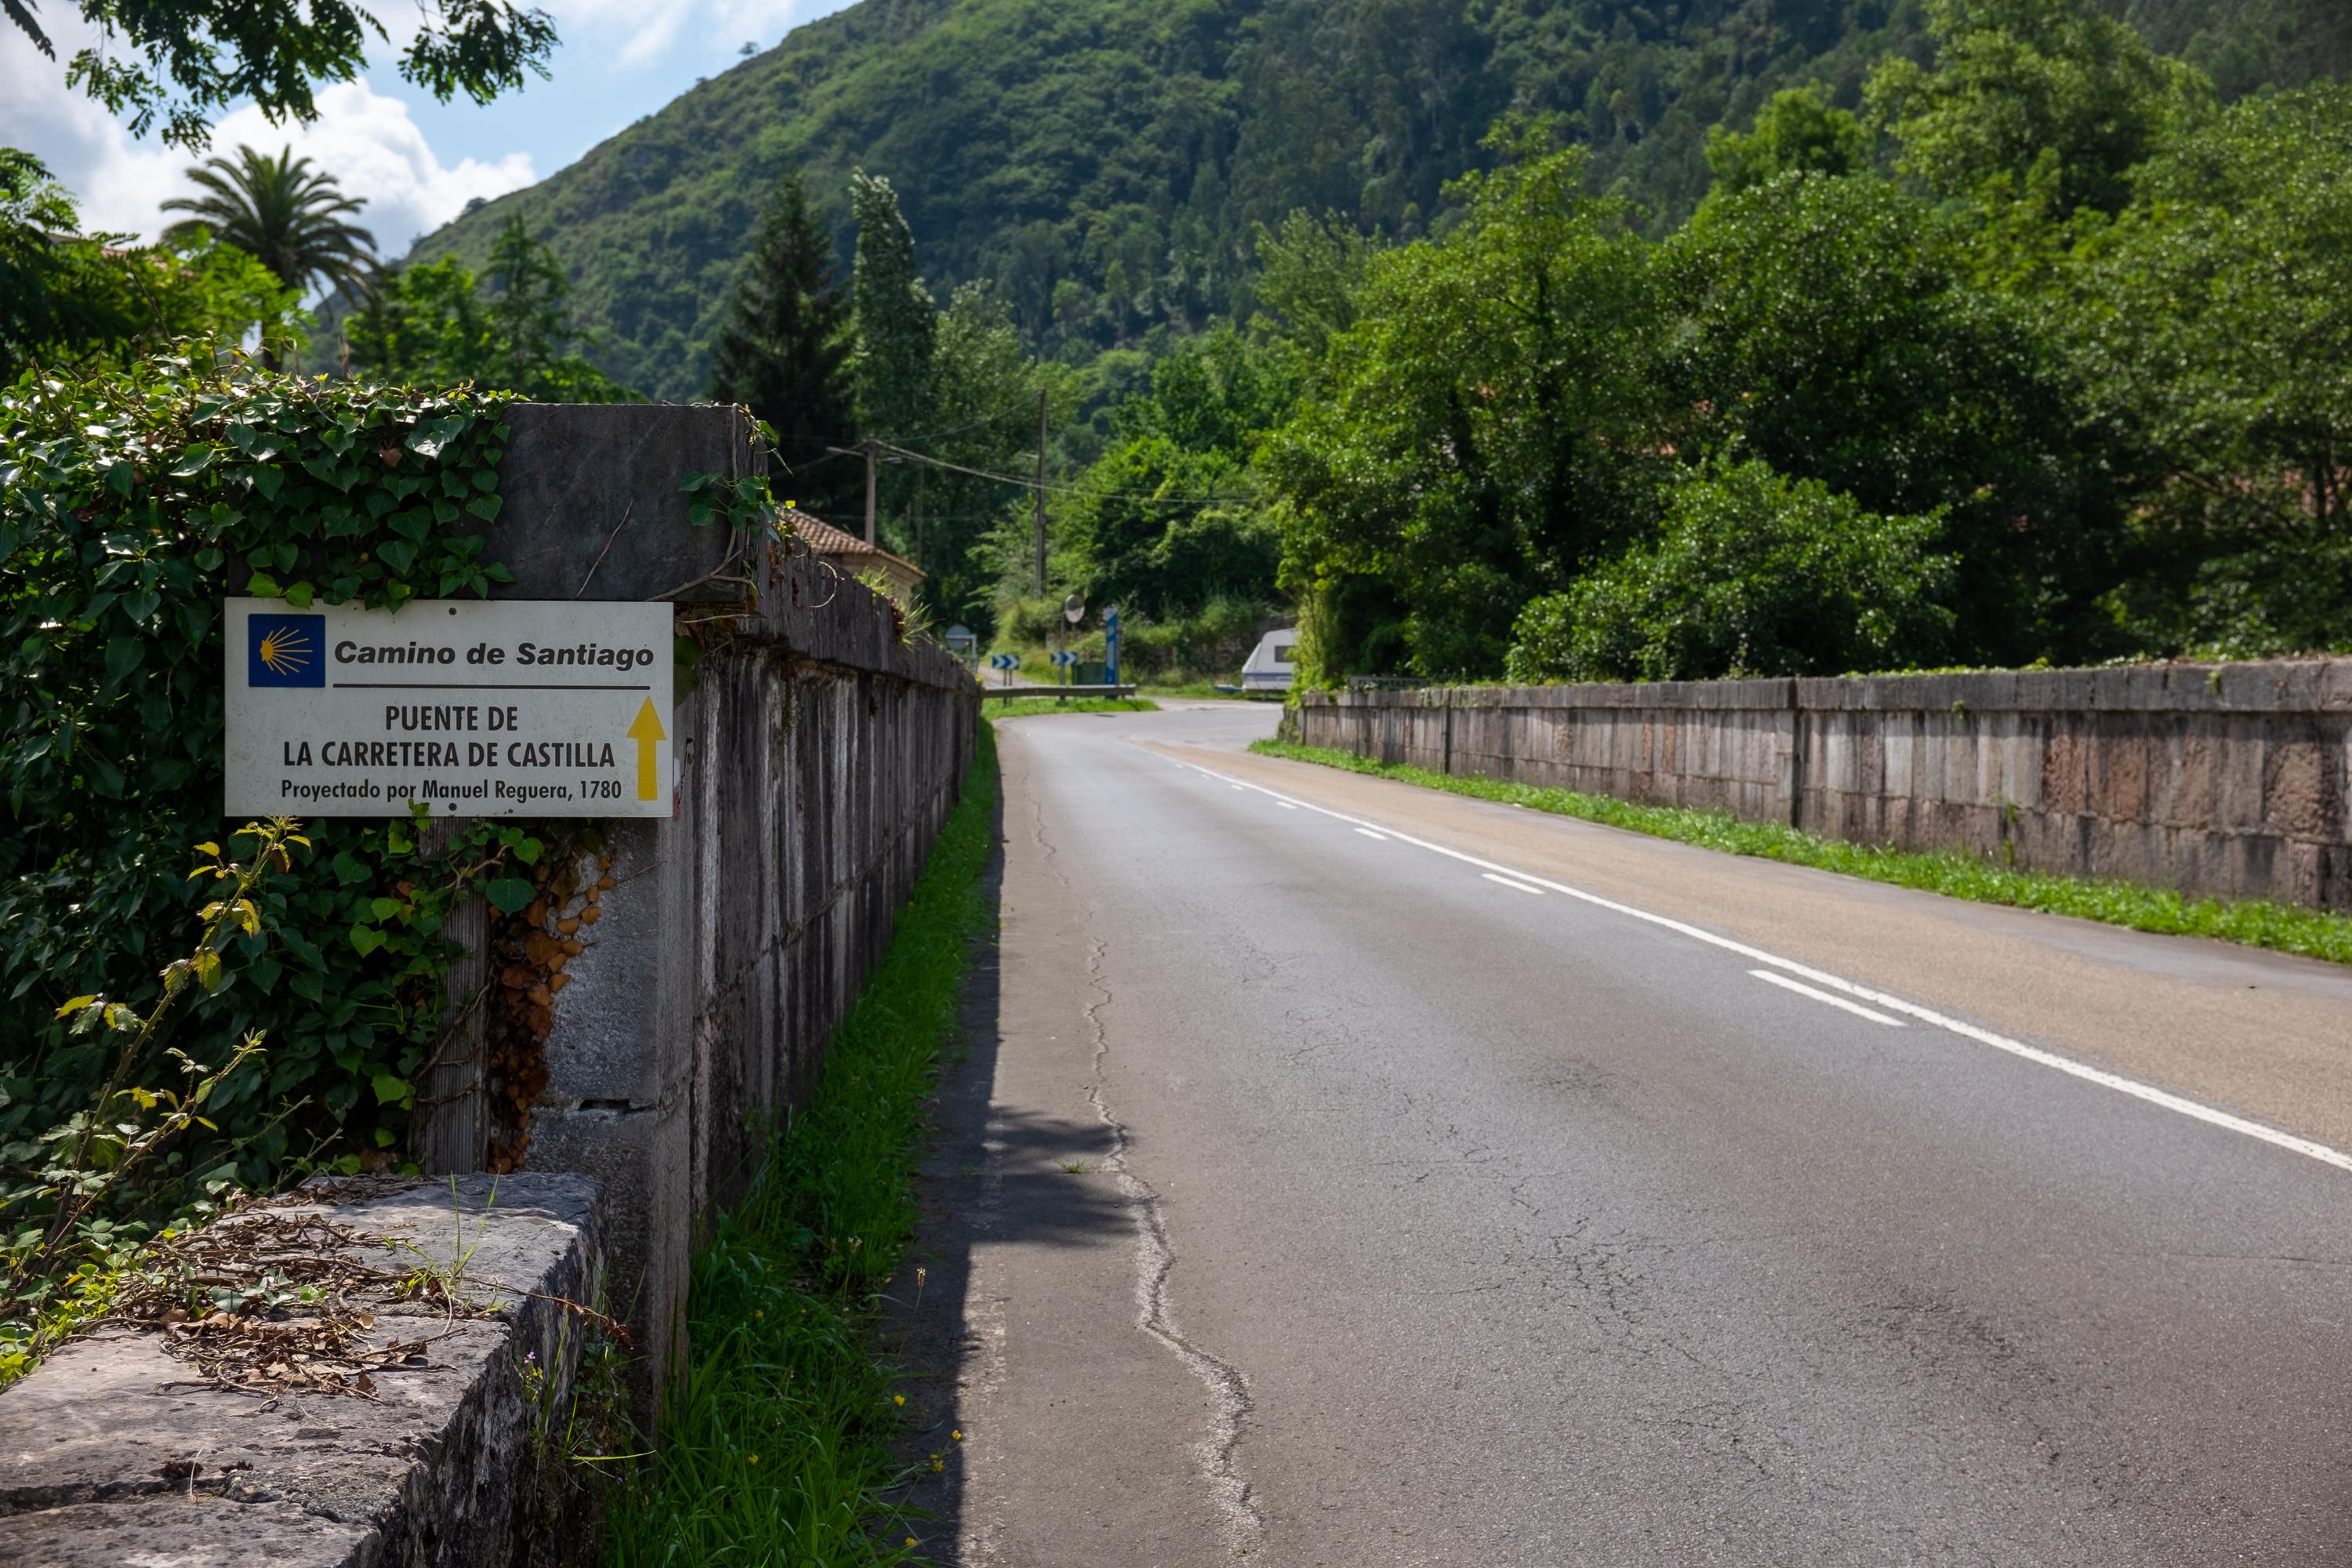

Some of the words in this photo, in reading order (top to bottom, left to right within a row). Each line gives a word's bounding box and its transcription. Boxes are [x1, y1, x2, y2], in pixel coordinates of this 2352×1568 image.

[334, 641, 456, 665] Camino
[466, 642, 506, 665] de
[516, 642, 654, 672] Santiago
[386, 706, 478, 731] PUENTE
[488, 706, 518, 731] DE
[284, 741, 314, 767] LA
[321, 741, 459, 767] CARRETERA
[468, 742, 499, 767] DE
[507, 742, 615, 768] CASTILLA
[281, 778, 381, 803] Proyectado
[387, 785, 416, 803] por
[422, 779, 488, 799] Manuel
[495, 780, 573, 804] Reguera,
[580, 780, 622, 799] 1780
